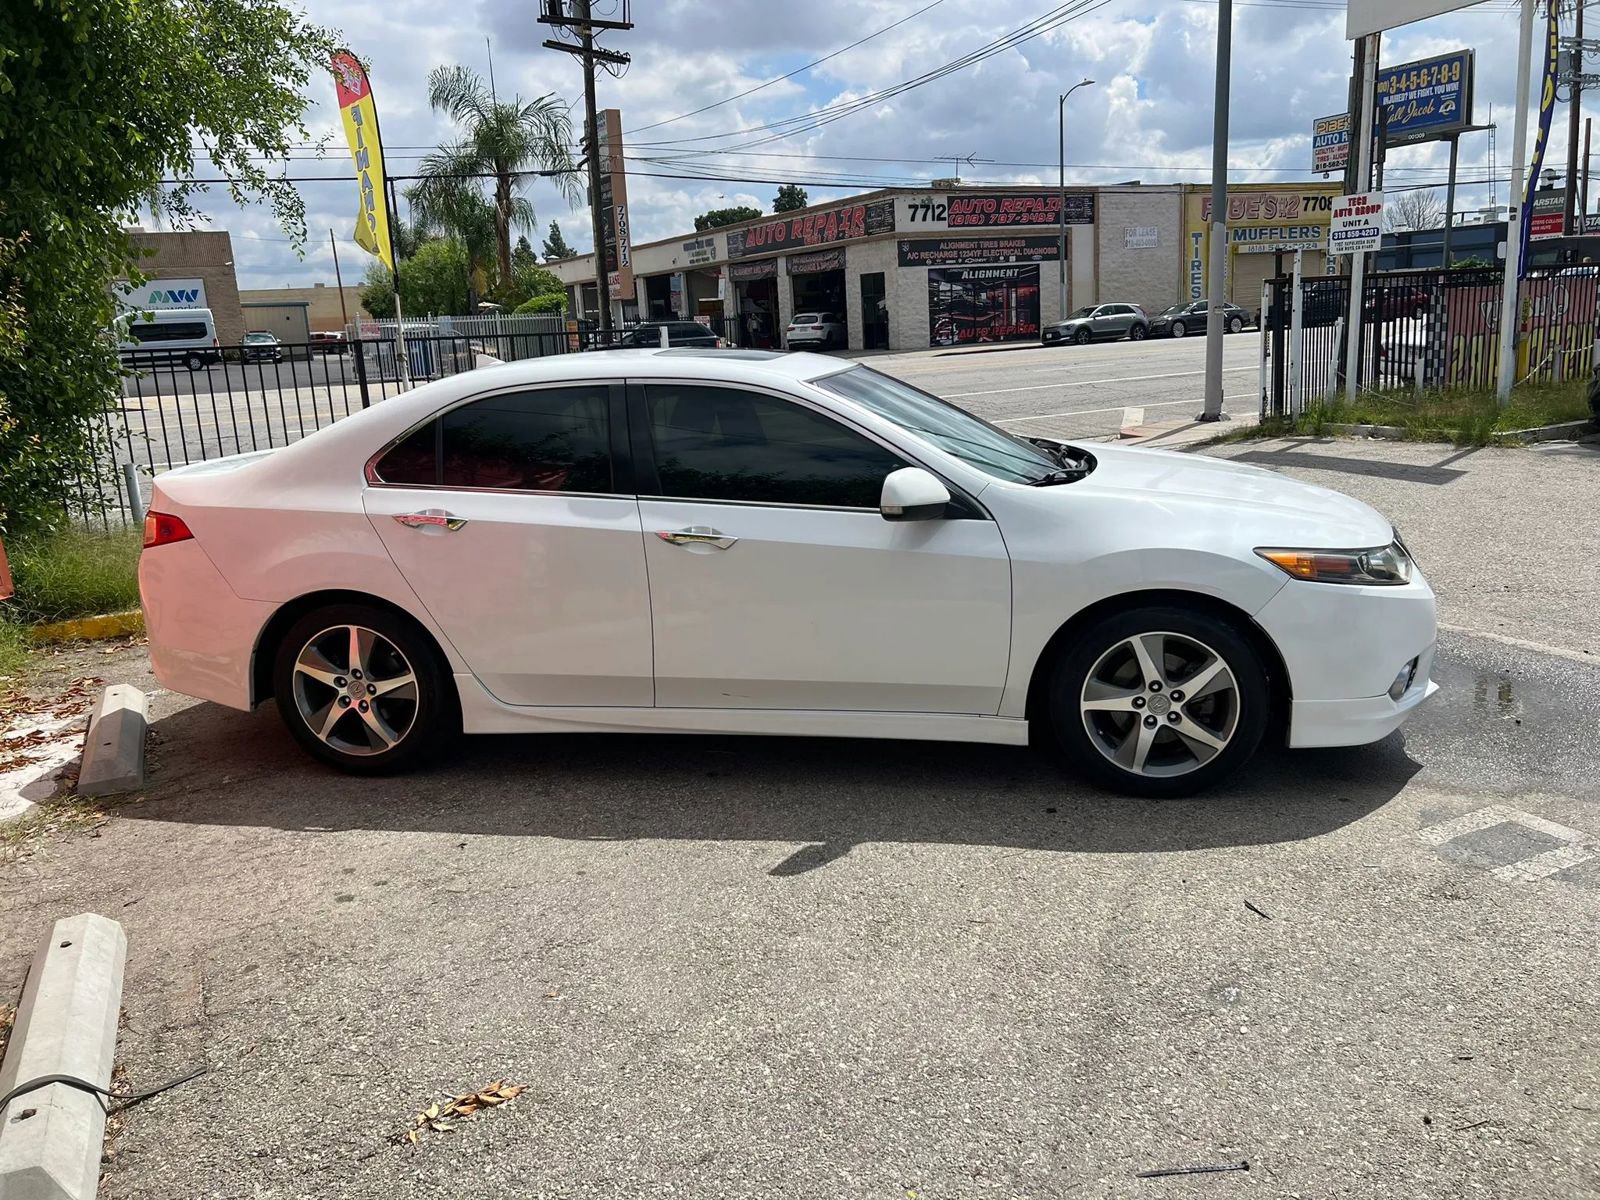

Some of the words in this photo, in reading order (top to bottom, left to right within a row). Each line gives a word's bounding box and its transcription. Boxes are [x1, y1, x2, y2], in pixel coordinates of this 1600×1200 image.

[1389, 61, 1460, 94] 3-4-5-6-7-8-9
[1408, 90, 1417, 100] WE
[1434, 84, 1445, 95] YOU
[1402, 98, 1435, 124] Jacob
[1315, 133, 1340, 148] AUTO
[949, 198, 998, 214] AUTO
[1201, 193, 1278, 221] PBE'S
[1302, 197, 1333, 212] 7708
[1347, 196, 1367, 207] TECH
[1533, 197, 1565, 206] ARSTAR
[908, 203, 947, 222] 7712
[1333, 208, 1353, 218] AUTO
[1355, 204, 1381, 216] GROUP
[617, 206, 627, 235] 7708
[745, 222, 786, 248] AUTO
[791, 206, 866, 240] REPAIR
[1342, 220, 1361, 228] UNIT
[1232, 225, 1321, 242] MUFFLERS
[1333, 231, 1346, 239] 310
[939, 241, 979, 250] ALIGNMENT
[980, 240, 998, 249] TIRES
[999, 239, 1026, 248] BRAKES
[619, 239, 629, 267] 7712
[907, 252, 919, 260] A/C
[920, 250, 958, 259] RECHARGE
[959, 249, 982, 258] 1234YF
[983, 248, 1022, 257] ELECTRICAL
[1023, 247, 1058, 255] DIAGNOSIS
[1190, 232, 1203, 299] TIRES
[961, 268, 1020, 280] ALIGNMENT
[959, 327, 989, 338] AUTO
